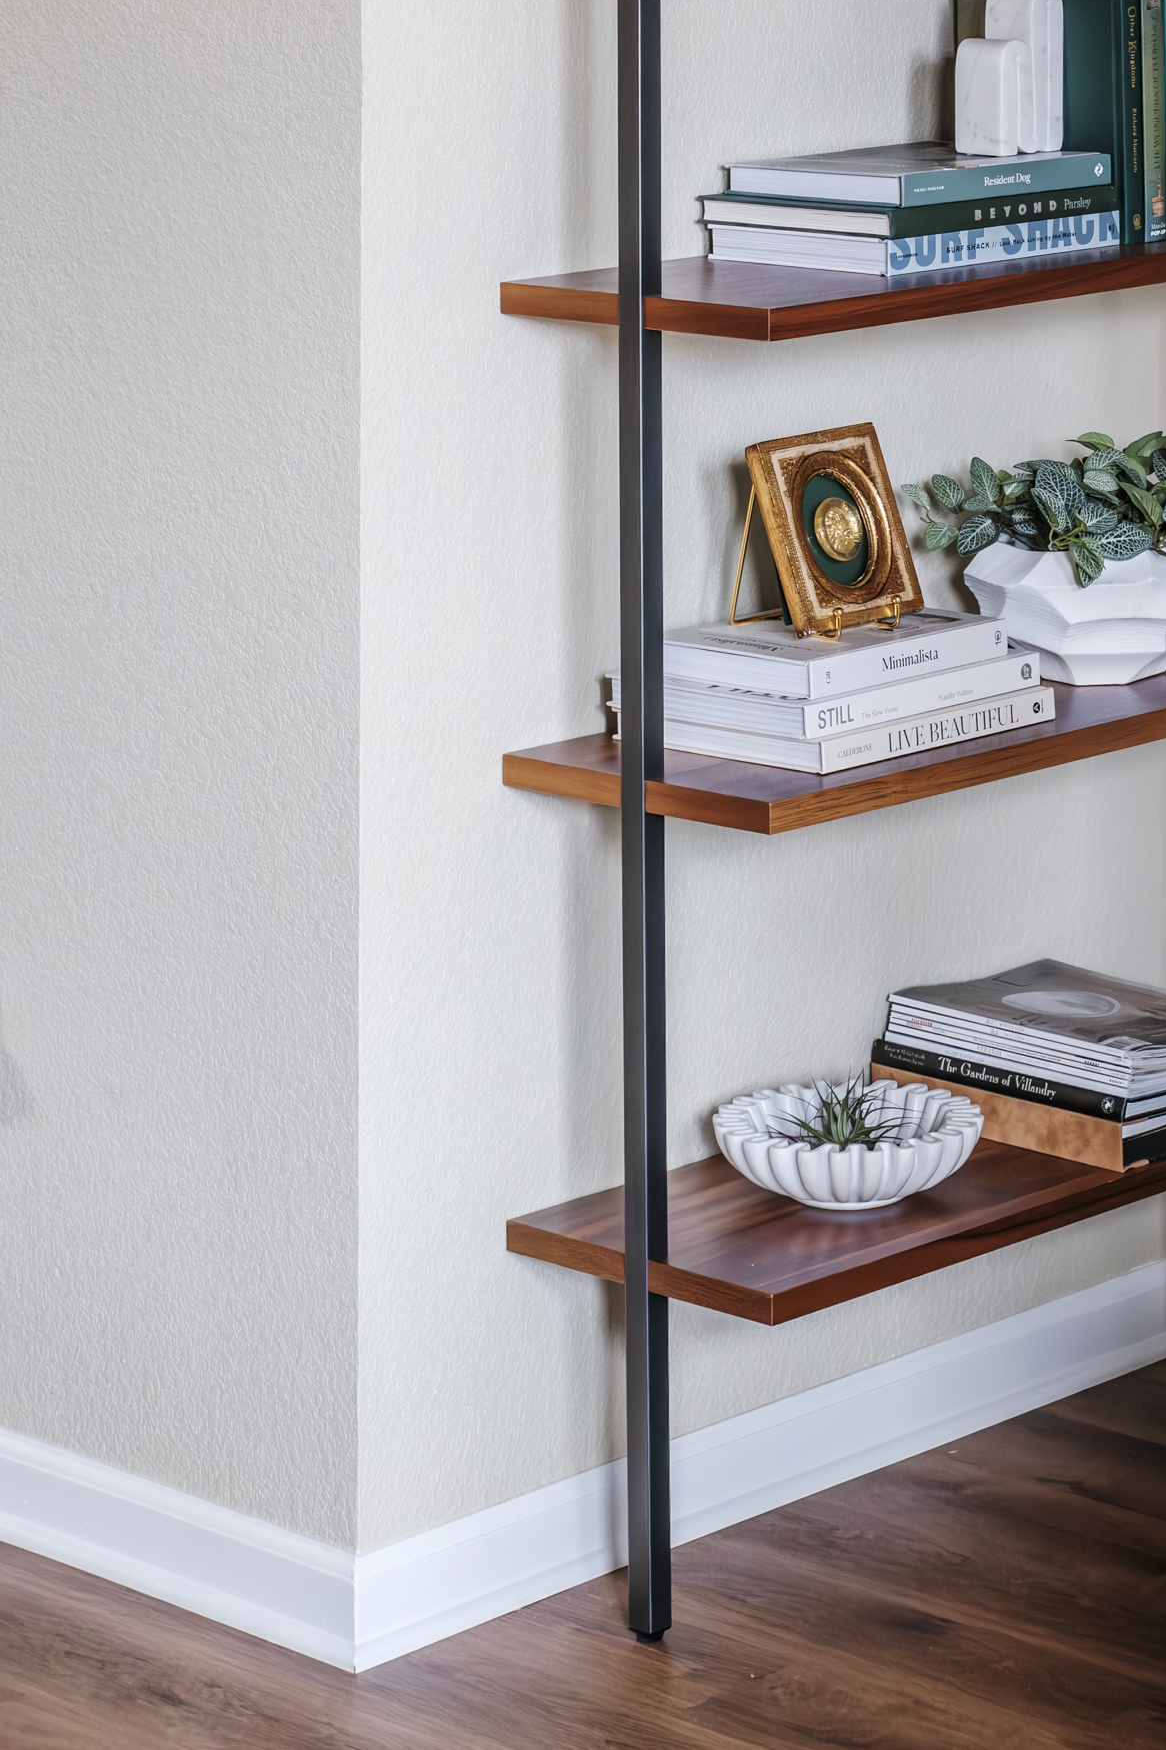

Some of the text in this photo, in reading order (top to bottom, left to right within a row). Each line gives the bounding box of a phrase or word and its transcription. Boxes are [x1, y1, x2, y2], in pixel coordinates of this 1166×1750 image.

[983, 173, 1031, 187] Resident Dog
[974, 197, 1092, 221] BEYOND Parsley
[946, 245, 964, 254] SURF
[966, 242, 990, 251] SHACK
[881, 649, 939, 672] Minimalista
[817, 704, 855, 730] STILL
[837, 743, 873, 759] CALDERONE
[887, 727, 926, 753] LIVE
[929, 704, 1019, 744] BEAUTIFUL
[938, 1056, 957, 1074] The
[960, 1062, 999, 1084] Gardens
[1001, 1074, 1013, 1087] of
[1014, 1074, 1057, 1101] Villandry
